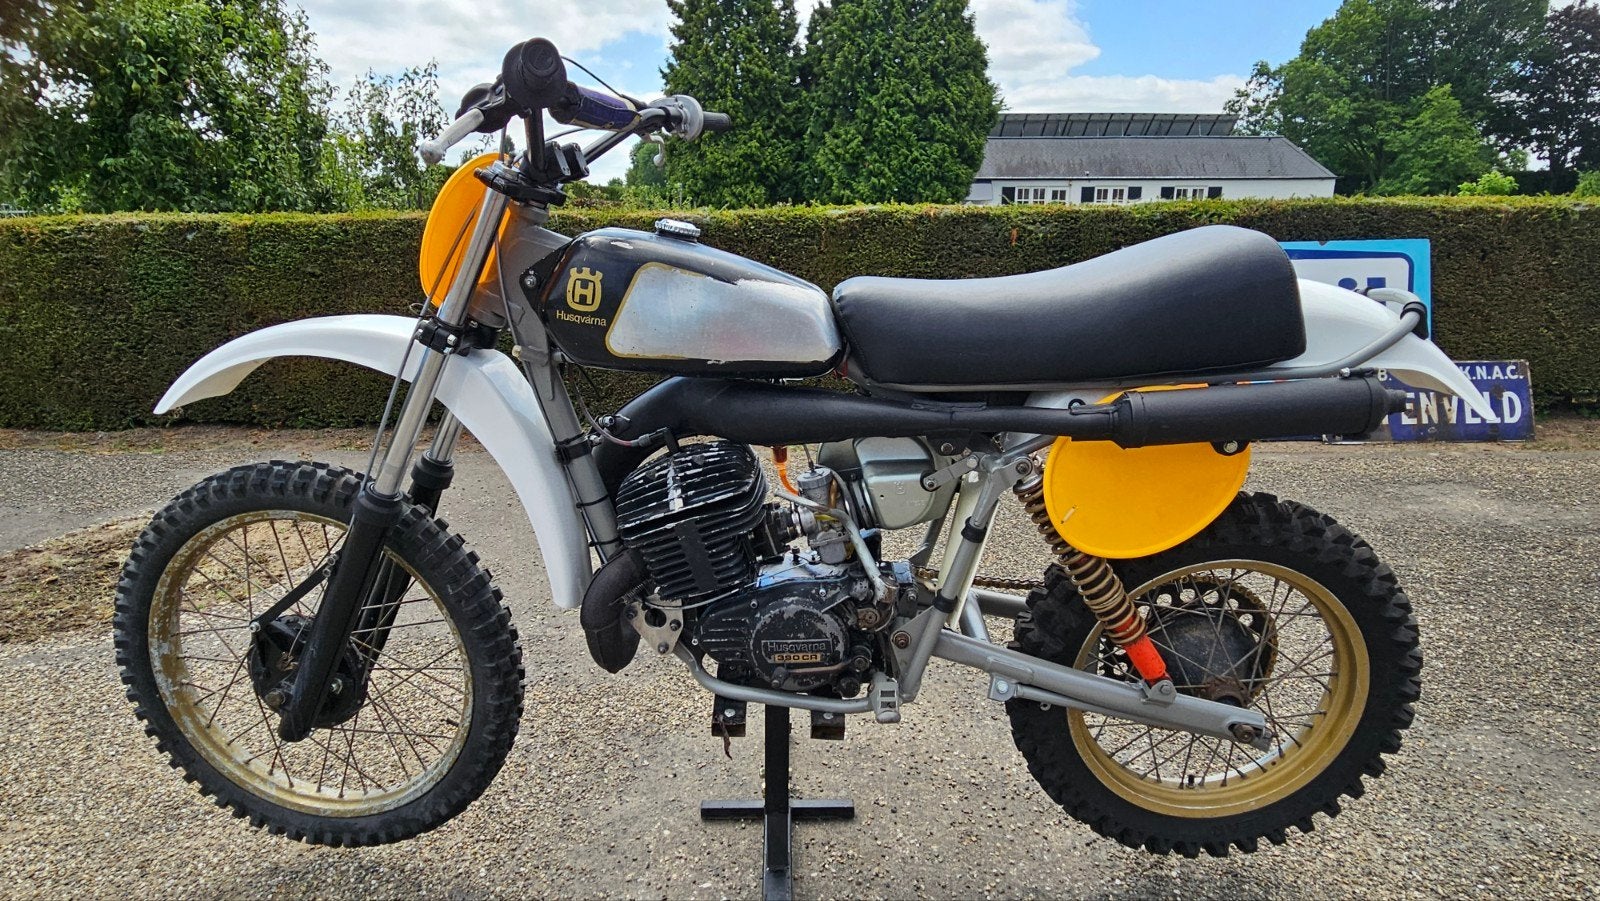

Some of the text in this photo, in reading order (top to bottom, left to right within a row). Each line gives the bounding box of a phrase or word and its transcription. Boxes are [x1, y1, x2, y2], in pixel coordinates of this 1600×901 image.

[574, 280, 594, 304] H
[1381, 391, 1522, 425] ENVELD
[767, 642, 826, 653] Husqvarna
